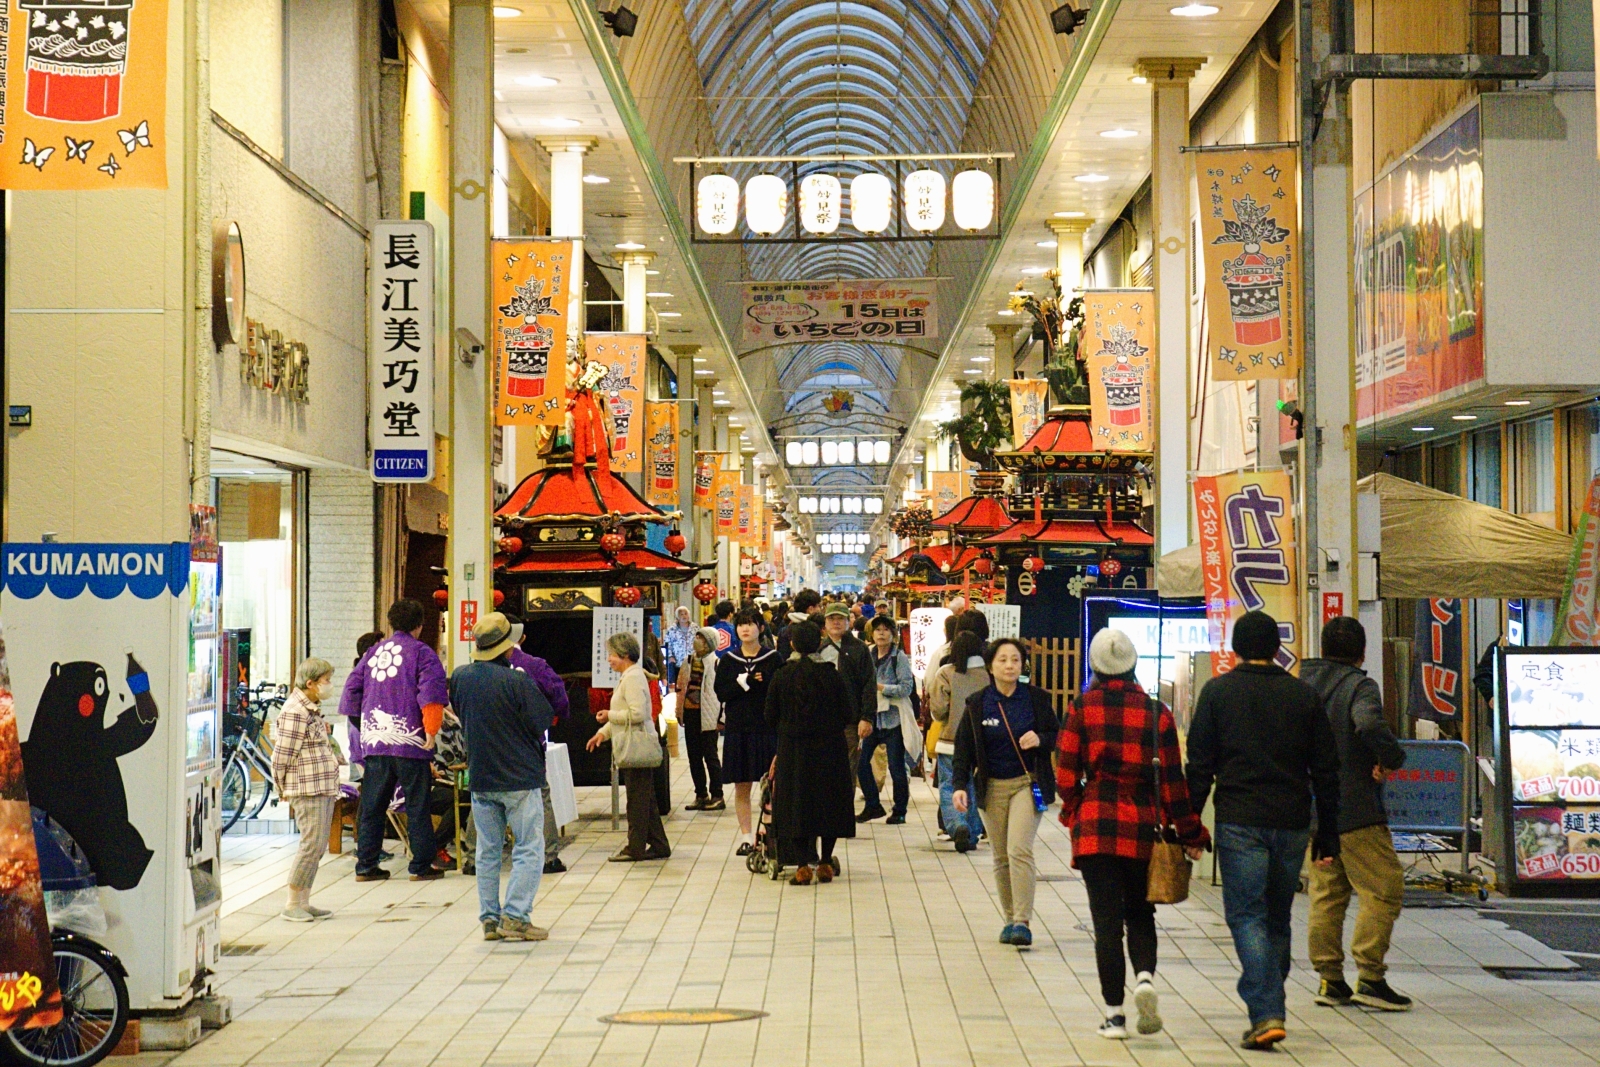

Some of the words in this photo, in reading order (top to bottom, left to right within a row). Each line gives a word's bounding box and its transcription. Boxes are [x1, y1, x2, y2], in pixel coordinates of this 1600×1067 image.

[711, 191, 727, 225] 妙見祭
[815, 190, 832, 224] 妙見祭
[917, 186, 934, 220] 妙見祭
[807, 289, 930, 300] お客様感謝デー
[841, 303, 924, 318] 15日は
[382, 233, 421, 437] 長江美巧堂
[773, 320, 924, 337] いちごの日
[375, 457, 425, 470] CITIZEN
[8, 551, 165, 577] KUMAMON
[1521, 660, 1565, 682] 定食
[1522, 775, 1554, 797] 全品
[1558, 778, 1600, 797] 700
[1525, 853, 1558, 877] 全品
